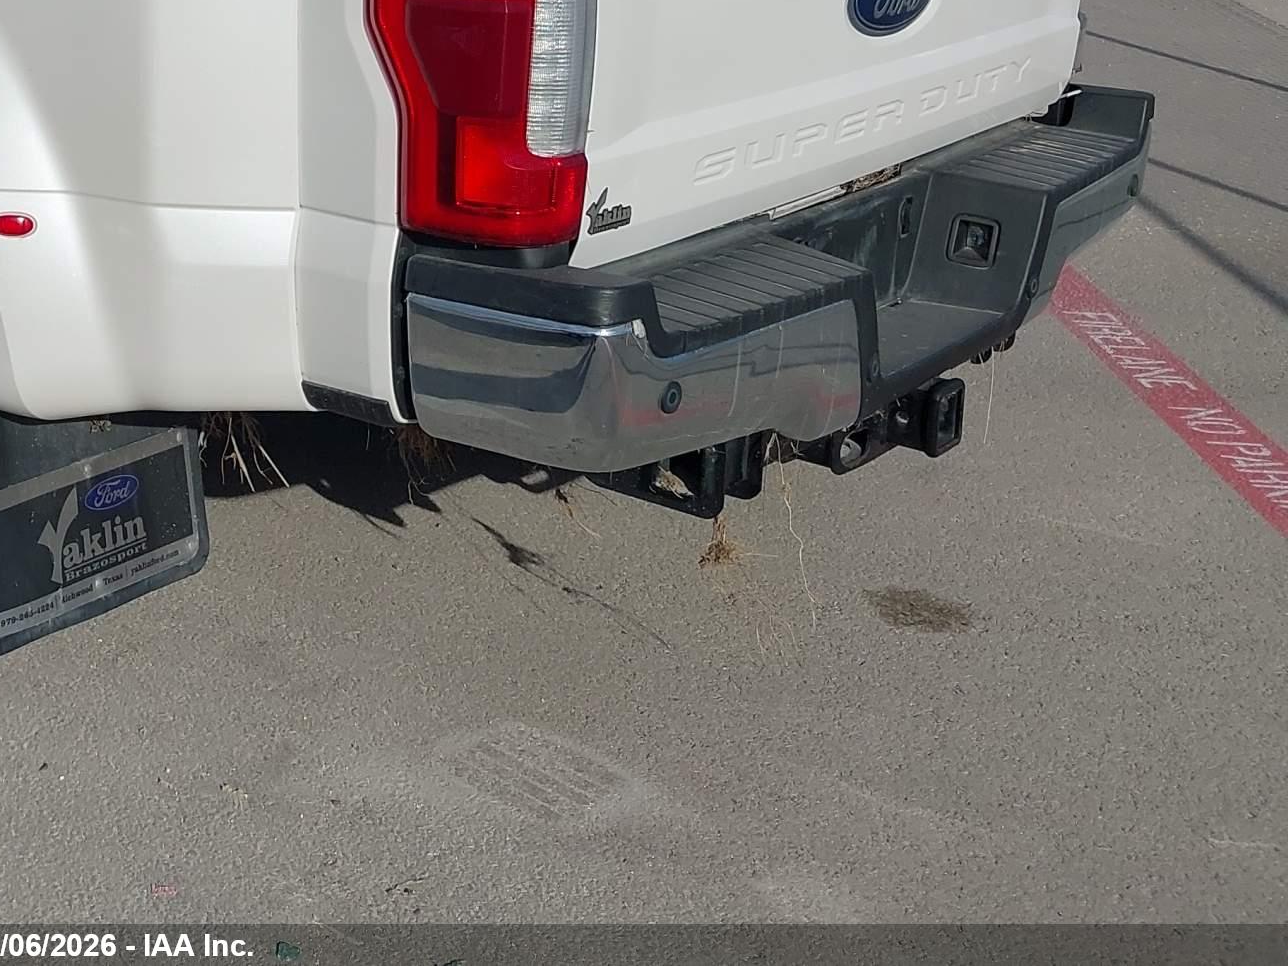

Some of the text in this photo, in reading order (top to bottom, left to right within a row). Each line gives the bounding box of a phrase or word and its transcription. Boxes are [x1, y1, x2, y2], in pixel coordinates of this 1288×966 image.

[693, 57, 1032, 186] SUPER DUTY
[1167, 406, 1247, 435] NO
[94, 479, 130, 508] Ford
[37, 485, 147, 585] Yaklin
[64, 542, 147, 582] Brazosport
